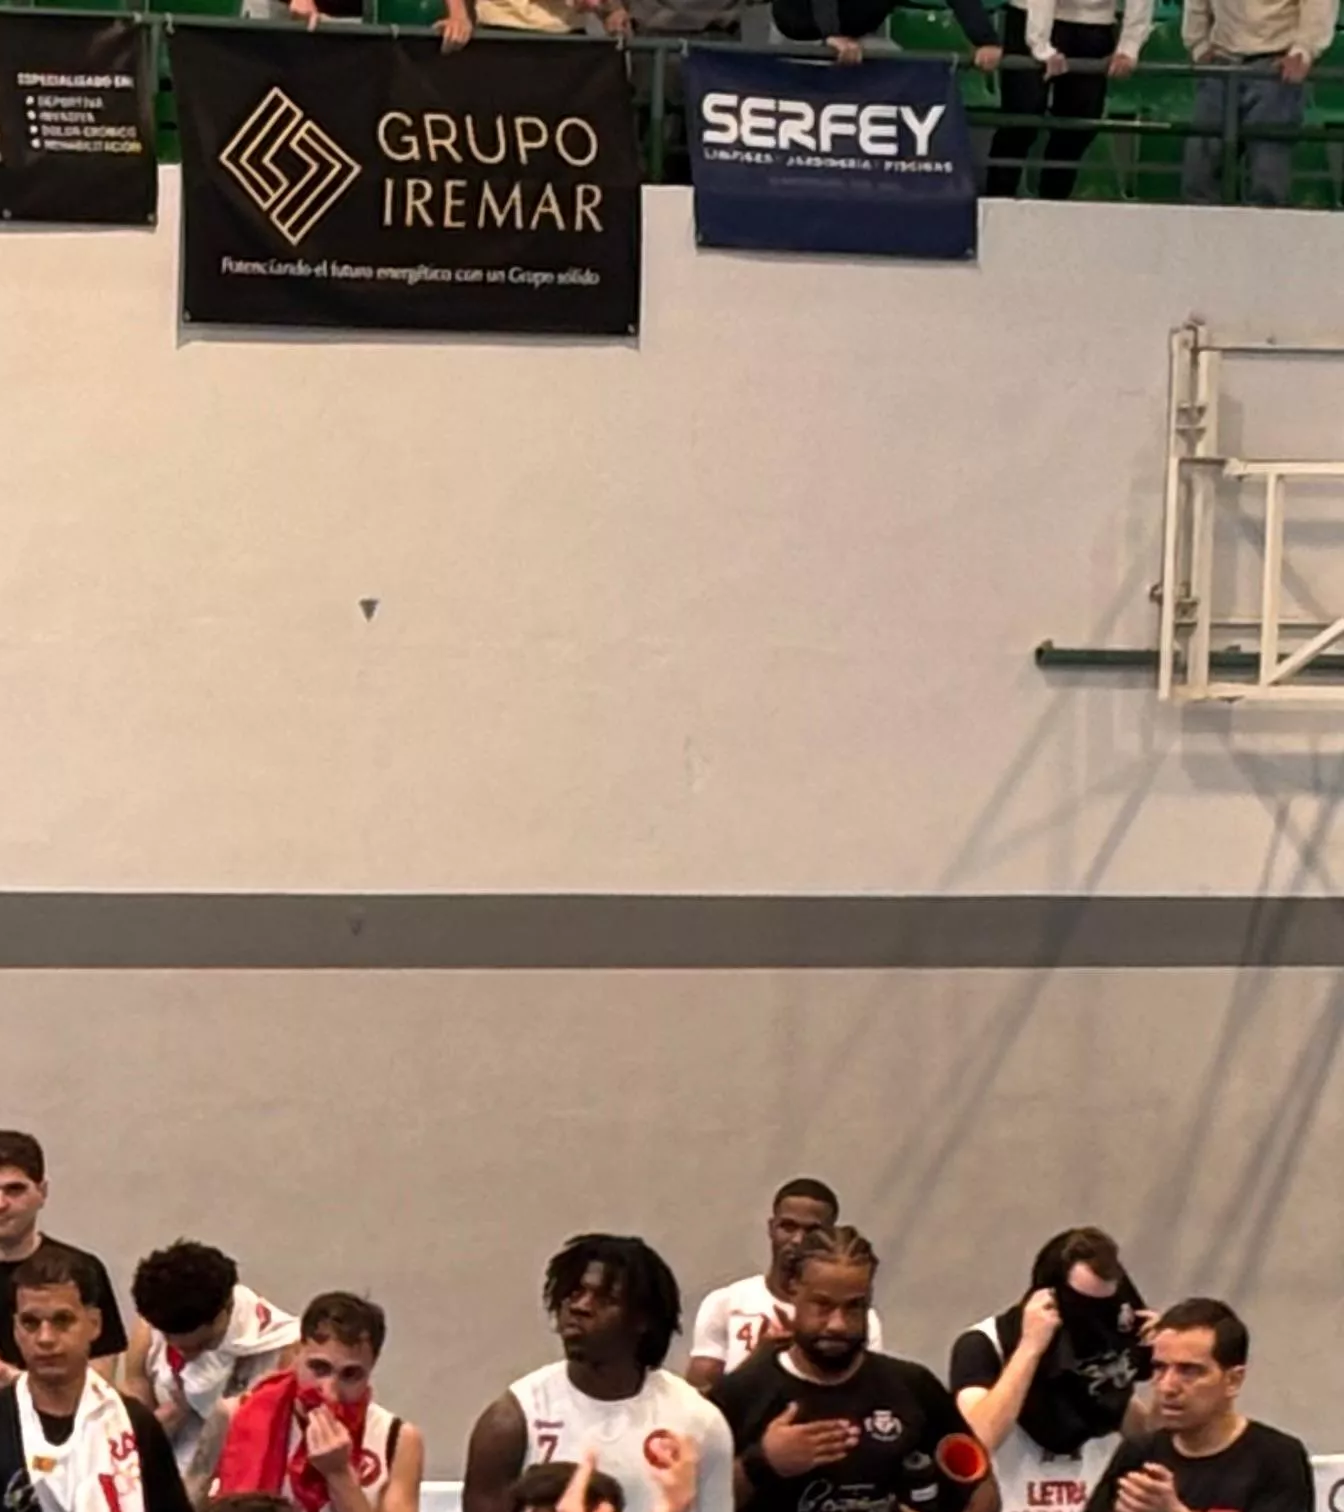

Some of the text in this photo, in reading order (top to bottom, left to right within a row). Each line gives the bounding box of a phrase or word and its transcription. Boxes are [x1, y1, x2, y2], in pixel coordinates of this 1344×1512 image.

[377, 111, 599, 167] GRUPO
[702, 92, 947, 157] SERFEY
[383, 177, 604, 233] IREMAR
